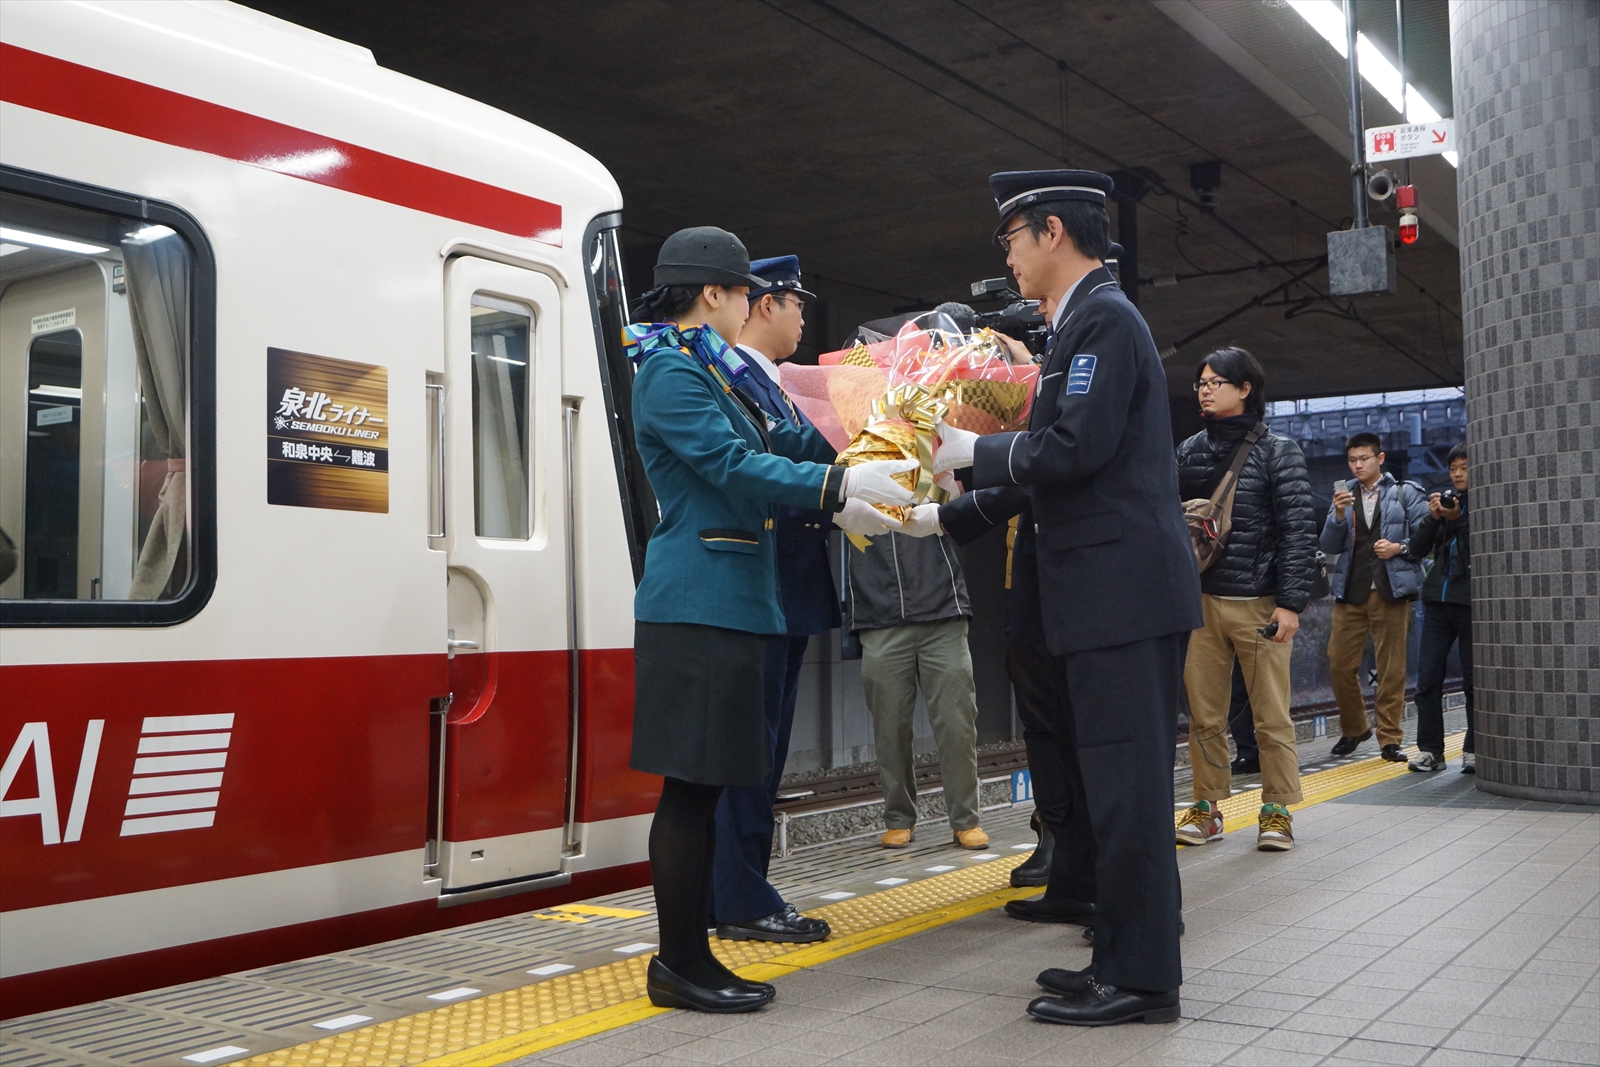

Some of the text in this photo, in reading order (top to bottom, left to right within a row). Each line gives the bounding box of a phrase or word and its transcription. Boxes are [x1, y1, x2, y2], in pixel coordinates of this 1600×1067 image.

[275, 387, 384, 425] 泉北ライナー
[290, 420, 380, 440] SEMBOKU LINER
[282, 441, 376, 467] 和泉中央 難波
